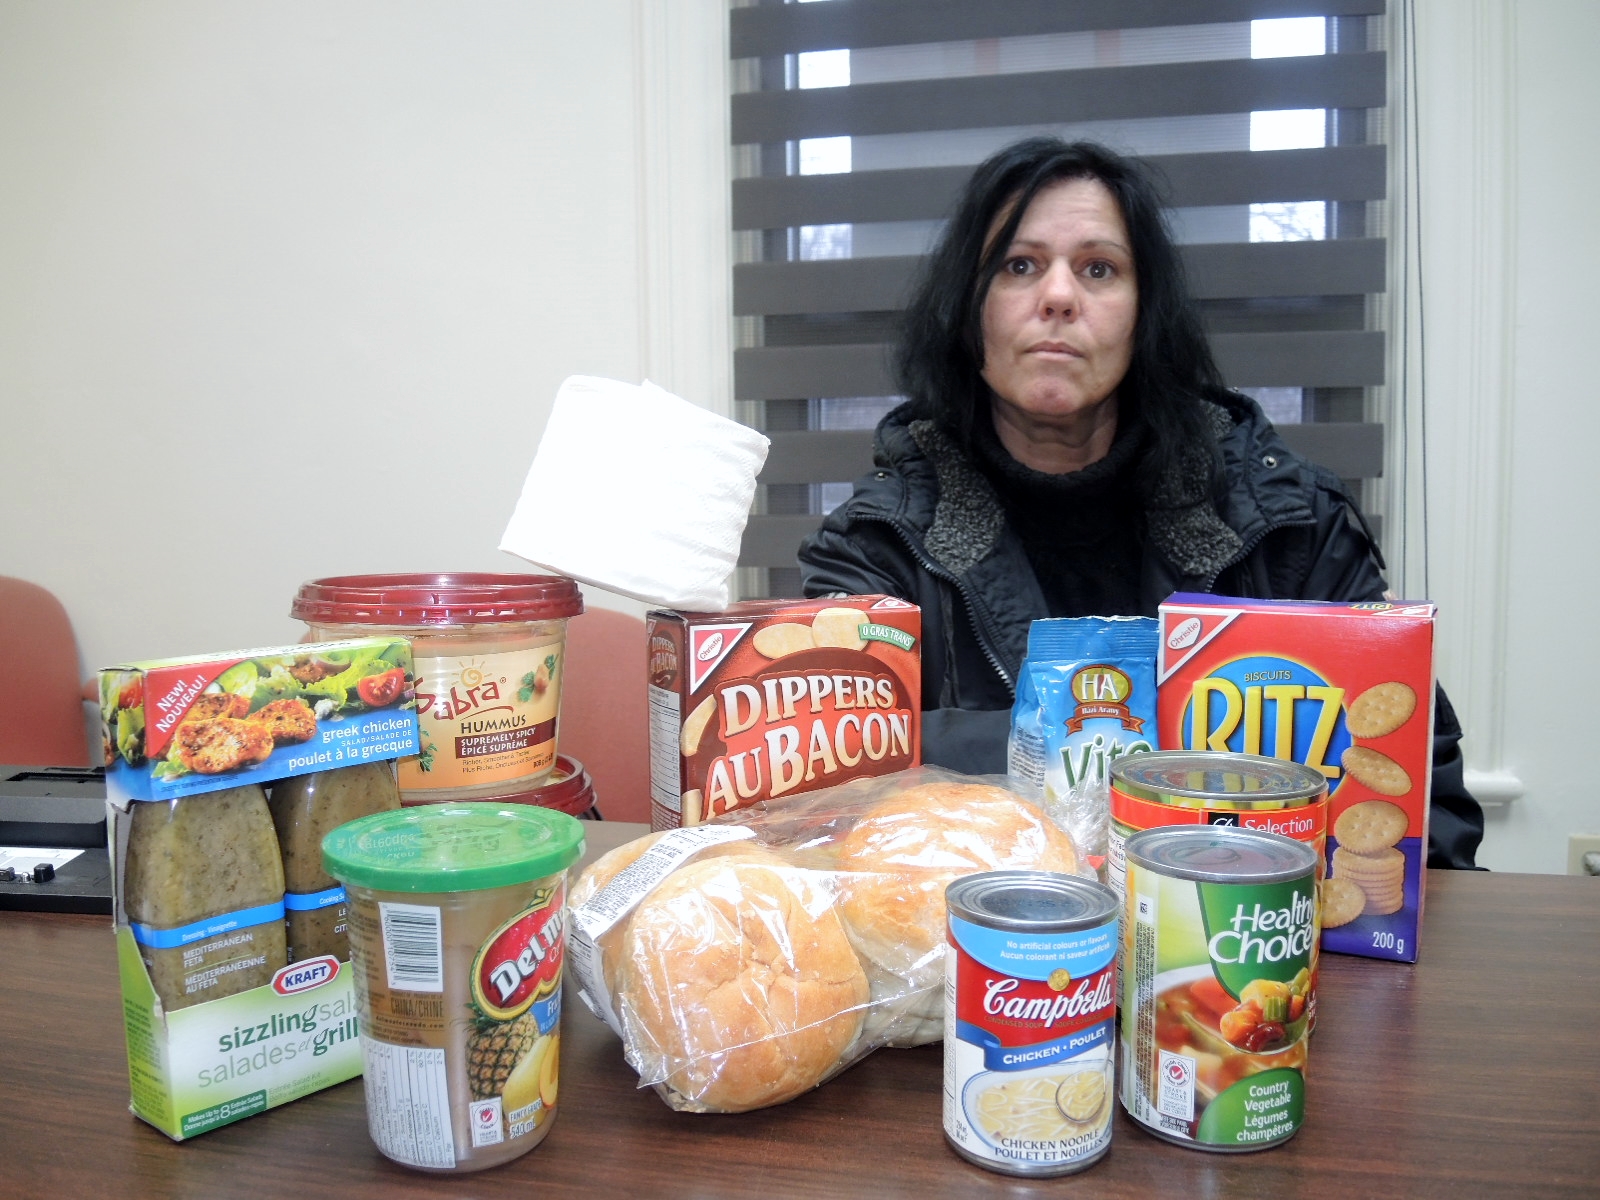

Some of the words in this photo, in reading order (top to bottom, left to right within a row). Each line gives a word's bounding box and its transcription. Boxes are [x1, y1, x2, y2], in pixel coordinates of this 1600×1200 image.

[862, 625, 868, 637] 0
[870, 625, 889, 638] GRAS
[890, 629, 912, 647] TRANS
[1169, 622, 1199, 648] Christie
[699, 635, 723, 661] Christie
[1081, 673, 1120, 700] HA
[1243, 669, 1292, 682] BISCUITS
[155, 674, 208, 733] NOUVEAU!
[156, 678, 188, 712] NEW!
[721, 674, 895, 737] DIPPERS
[322, 724, 360, 744] greek
[362, 717, 412, 735] chicken
[460, 714, 527, 734] HUMMUS
[1190, 677, 1346, 778] RITZ
[341, 732, 394, 747] SALAD/SALADE
[401, 729, 413, 738] DE
[461, 732, 514, 747] SUPREMELY
[516, 727, 536, 741] SPICY
[288, 751, 332, 771] poulet
[335, 748, 344, 761] à
[346, 746, 359, 759] la
[361, 738, 413, 760] grecque
[707, 746, 763, 819] AU
[764, 712, 911, 798] BACON
[1244, 816, 1313, 836] Selection
[1229, 890, 1314, 933] Healthy
[183, 932, 254, 960] MEDITERRANEAN
[1006, 940, 1018, 949] No
[1019, 942, 1052, 951] artificial
[1052, 940, 1078, 950] colours
[1208, 926, 1312, 964] Choice
[1371, 931, 1395, 949] 200
[1396, 938, 1405, 954] g
[184, 955, 204, 969] FETA
[1000, 950, 1024, 960] Aucun
[1025, 952, 1057, 961] colorant
[1059, 952, 1066, 960] ni
[1067, 950, 1088, 959] saveur
[284, 964, 328, 988] KRAFT
[489, 934, 547, 1002] Del
[185, 984, 198, 995] AU
[198, 977, 218, 990] FETA
[983, 971, 1113, 1028] Campbell's
[218, 1003, 319, 1053] sizzling
[1002, 1045, 1061, 1065] CHICKEN
[1069, 1026, 1106, 1050] POULET
[197, 1041, 297, 1088] salades
[298, 1034, 312, 1053] et
[1249, 1079, 1290, 1097] Country
[220, 1103, 231, 1119] 8
[1244, 1091, 1292, 1113] Vegetable
[511, 1122, 526, 1139] 540
[1236, 1119, 1293, 1141] champêtres
[1244, 1109, 1289, 1129] Légumes
[994, 1147, 1040, 1161] POULET
[1043, 1151, 1058, 1161] ET
[1060, 1138, 1103, 1158] NOUILLES
[1001, 1137, 1058, 1150] CHICKEN
[1059, 1128, 1100, 1148] NOODLE
